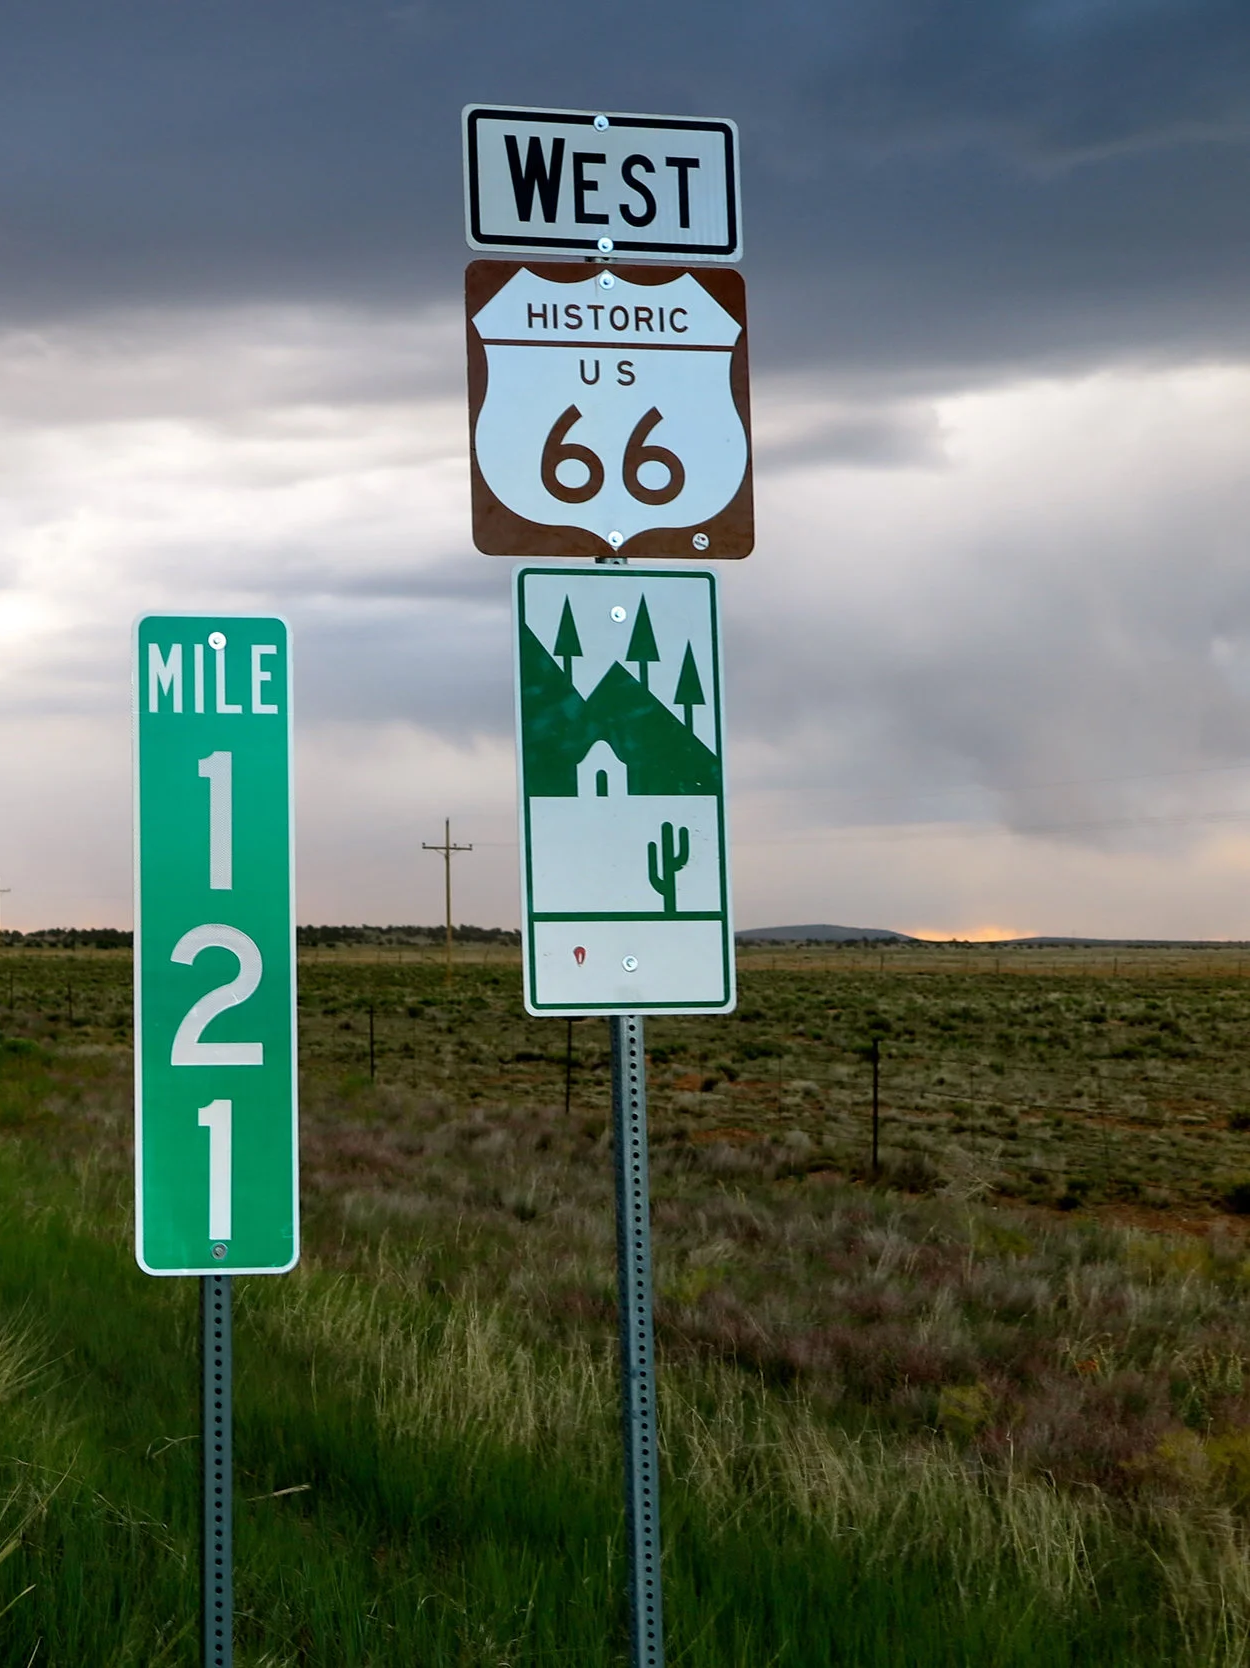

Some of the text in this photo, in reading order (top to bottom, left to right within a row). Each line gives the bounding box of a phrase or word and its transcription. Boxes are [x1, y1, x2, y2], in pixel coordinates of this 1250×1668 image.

[504, 134, 699, 228] WEST
[527, 303, 688, 333] HISTORIC
[579, 358, 636, 386] US
[541, 404, 686, 506] 66
[148, 643, 278, 714] MILE
